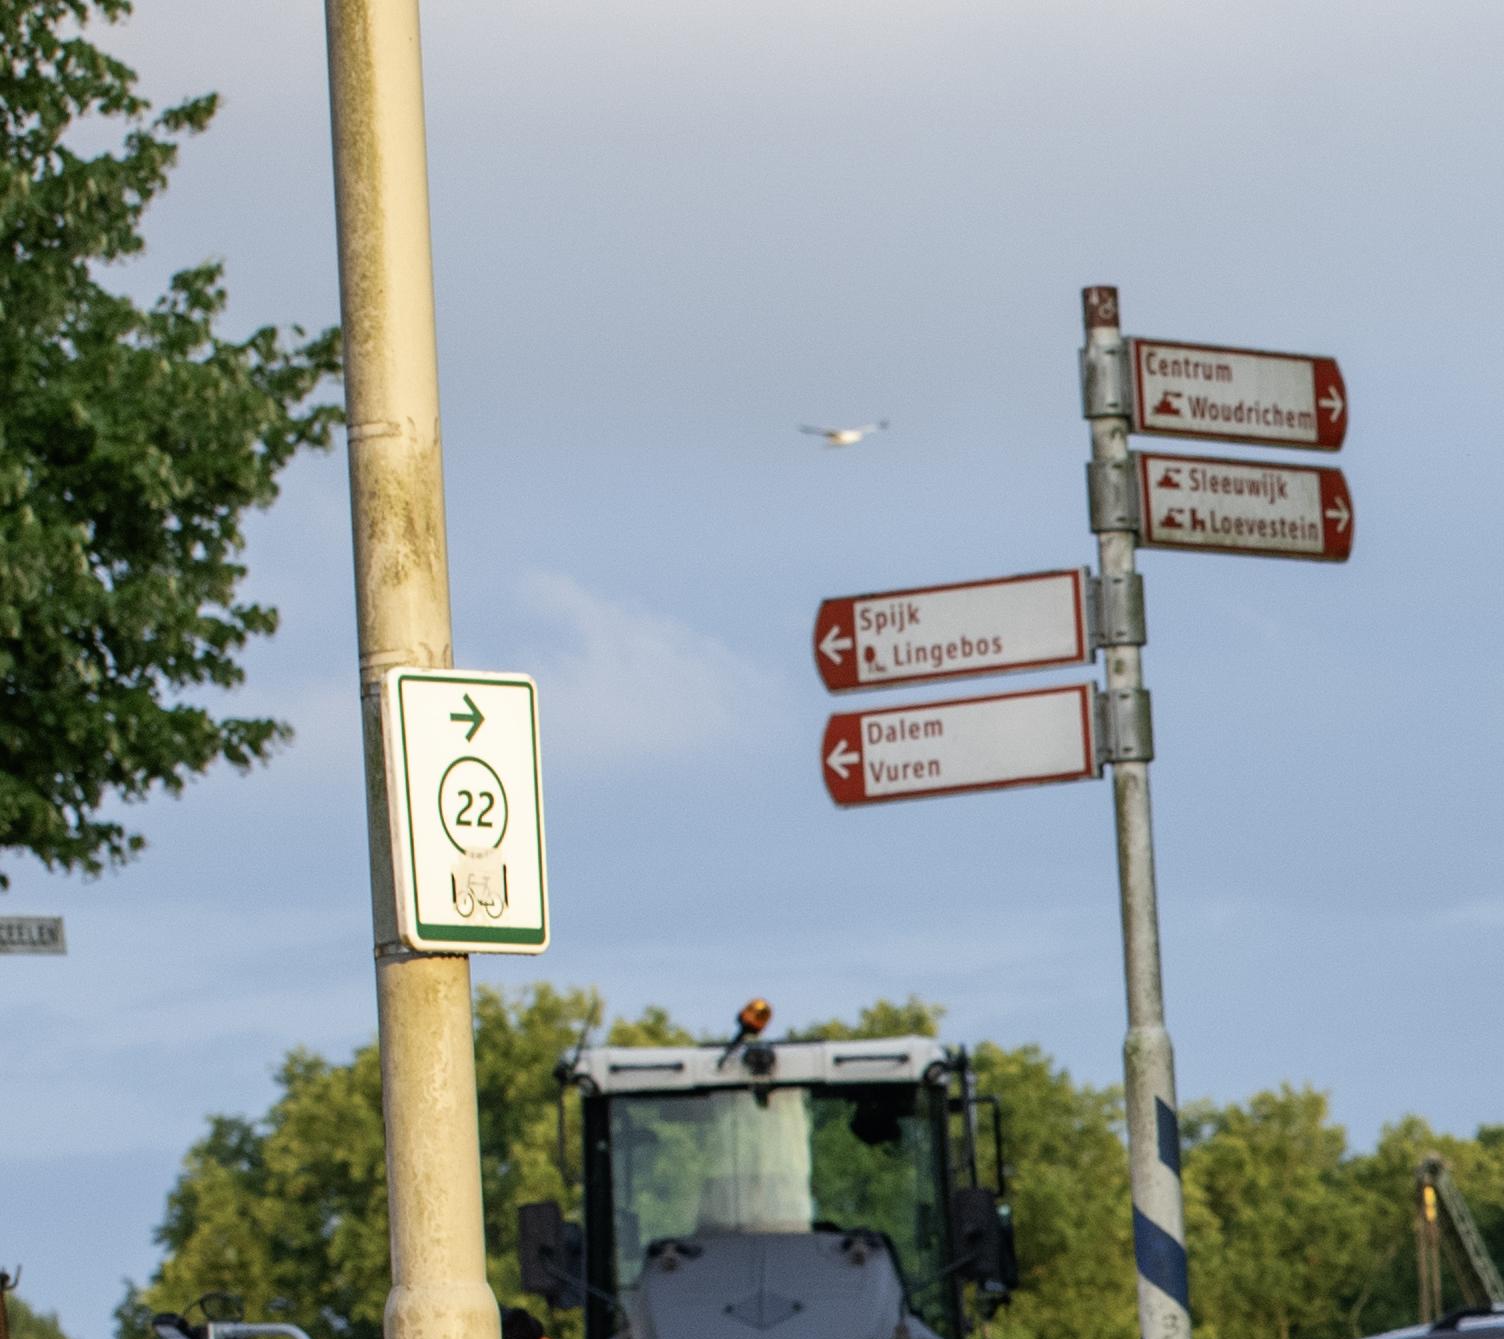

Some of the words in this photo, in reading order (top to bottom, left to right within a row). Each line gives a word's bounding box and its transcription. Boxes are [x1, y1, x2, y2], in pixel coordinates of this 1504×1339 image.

[1144, 351, 1232, 382] Centrum
[1187, 395, 1315, 431] Woudrichem
[1188, 469, 1289, 503] Sleeuwijk
[1209, 512, 1319, 542] Loevestein
[859, 602, 921, 634] Spijk
[892, 634, 1003, 671] Lingebos
[866, 716, 944, 745] Dalem
[869, 757, 941, 783] Vuren
[455, 789, 495, 828] 22
